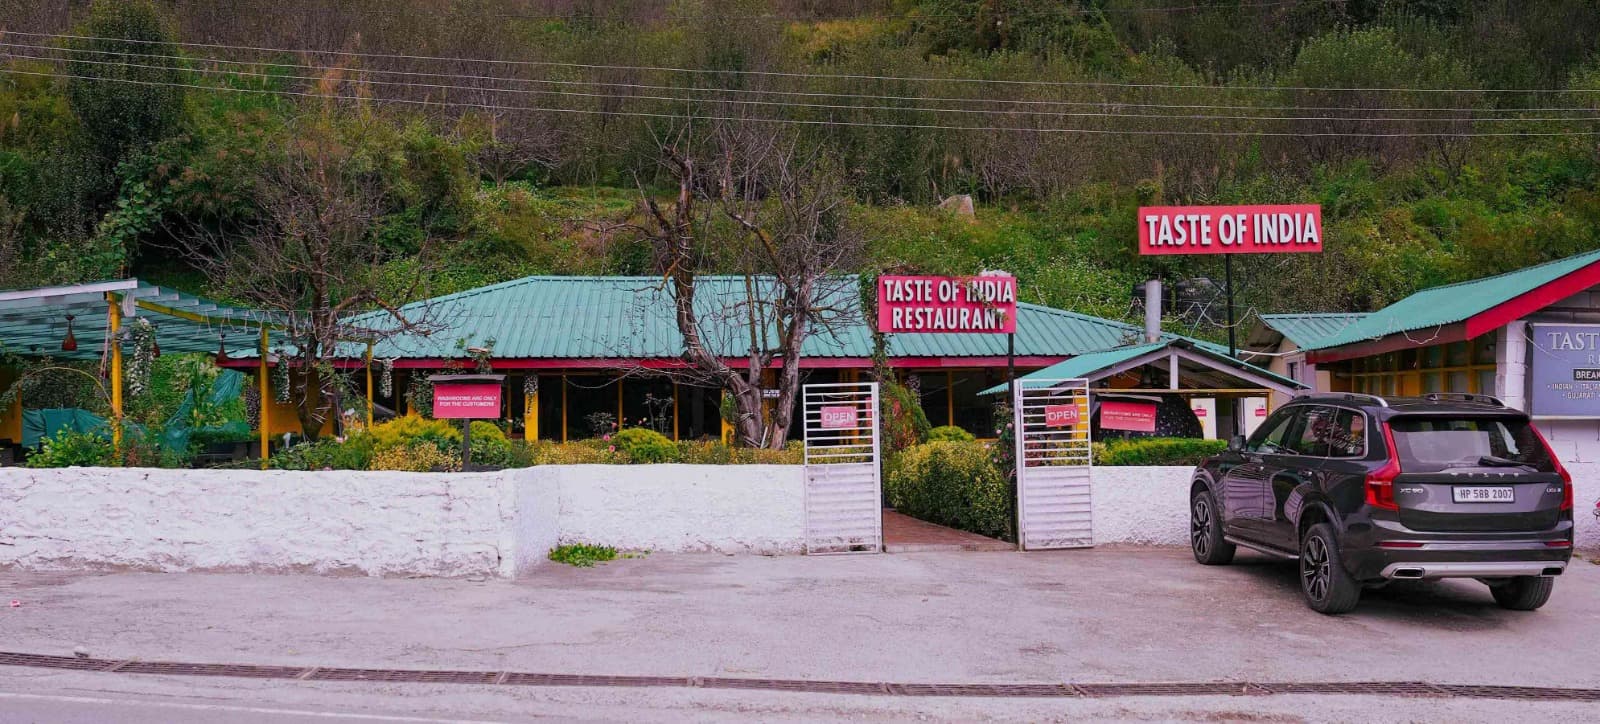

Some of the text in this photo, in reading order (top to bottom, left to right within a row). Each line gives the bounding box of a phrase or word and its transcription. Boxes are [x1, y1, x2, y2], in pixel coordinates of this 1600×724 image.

[1146, 213, 1319, 246] TASTE OF INDIA
[884, 280, 1014, 302] TASTE OF INDIA
[892, 307, 1006, 329] RESTAURANT
[1580, 383, 1600, 391] ITALIA
[824, 412, 855, 422] OPEN
[1048, 410, 1078, 420] OPEN
[1460, 489, 1472, 499] HP
[1492, 488, 1513, 499] 2007
